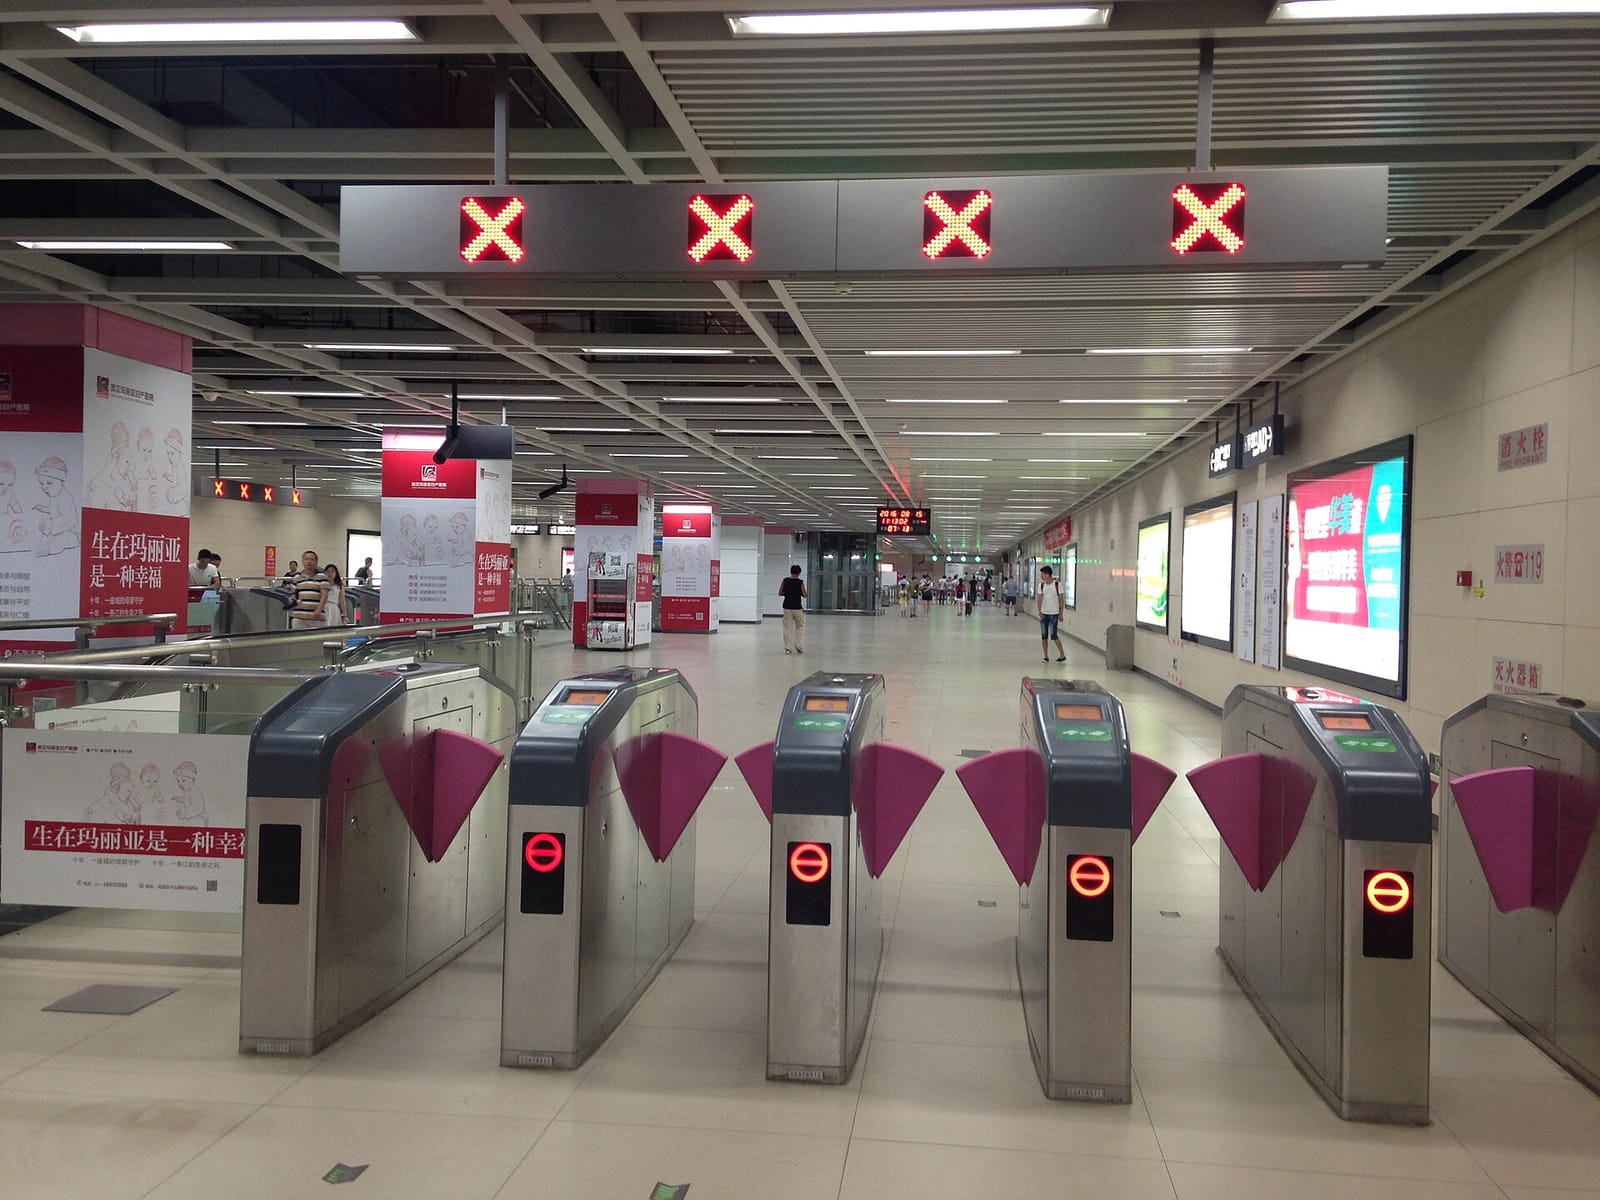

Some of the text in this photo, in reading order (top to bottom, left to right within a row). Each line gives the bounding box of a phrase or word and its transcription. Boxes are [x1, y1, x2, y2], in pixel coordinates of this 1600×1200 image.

[1501, 426, 1544, 458] 消火栓
[91, 530, 181, 563] 生在玛丽亚
[478, 553, 509, 570] 生在玛丽亚
[1525, 551, 1542, 579] 119
[90, 564, 162, 589] 是一种幸福
[1495, 661, 1538, 688] 灭火器箱
